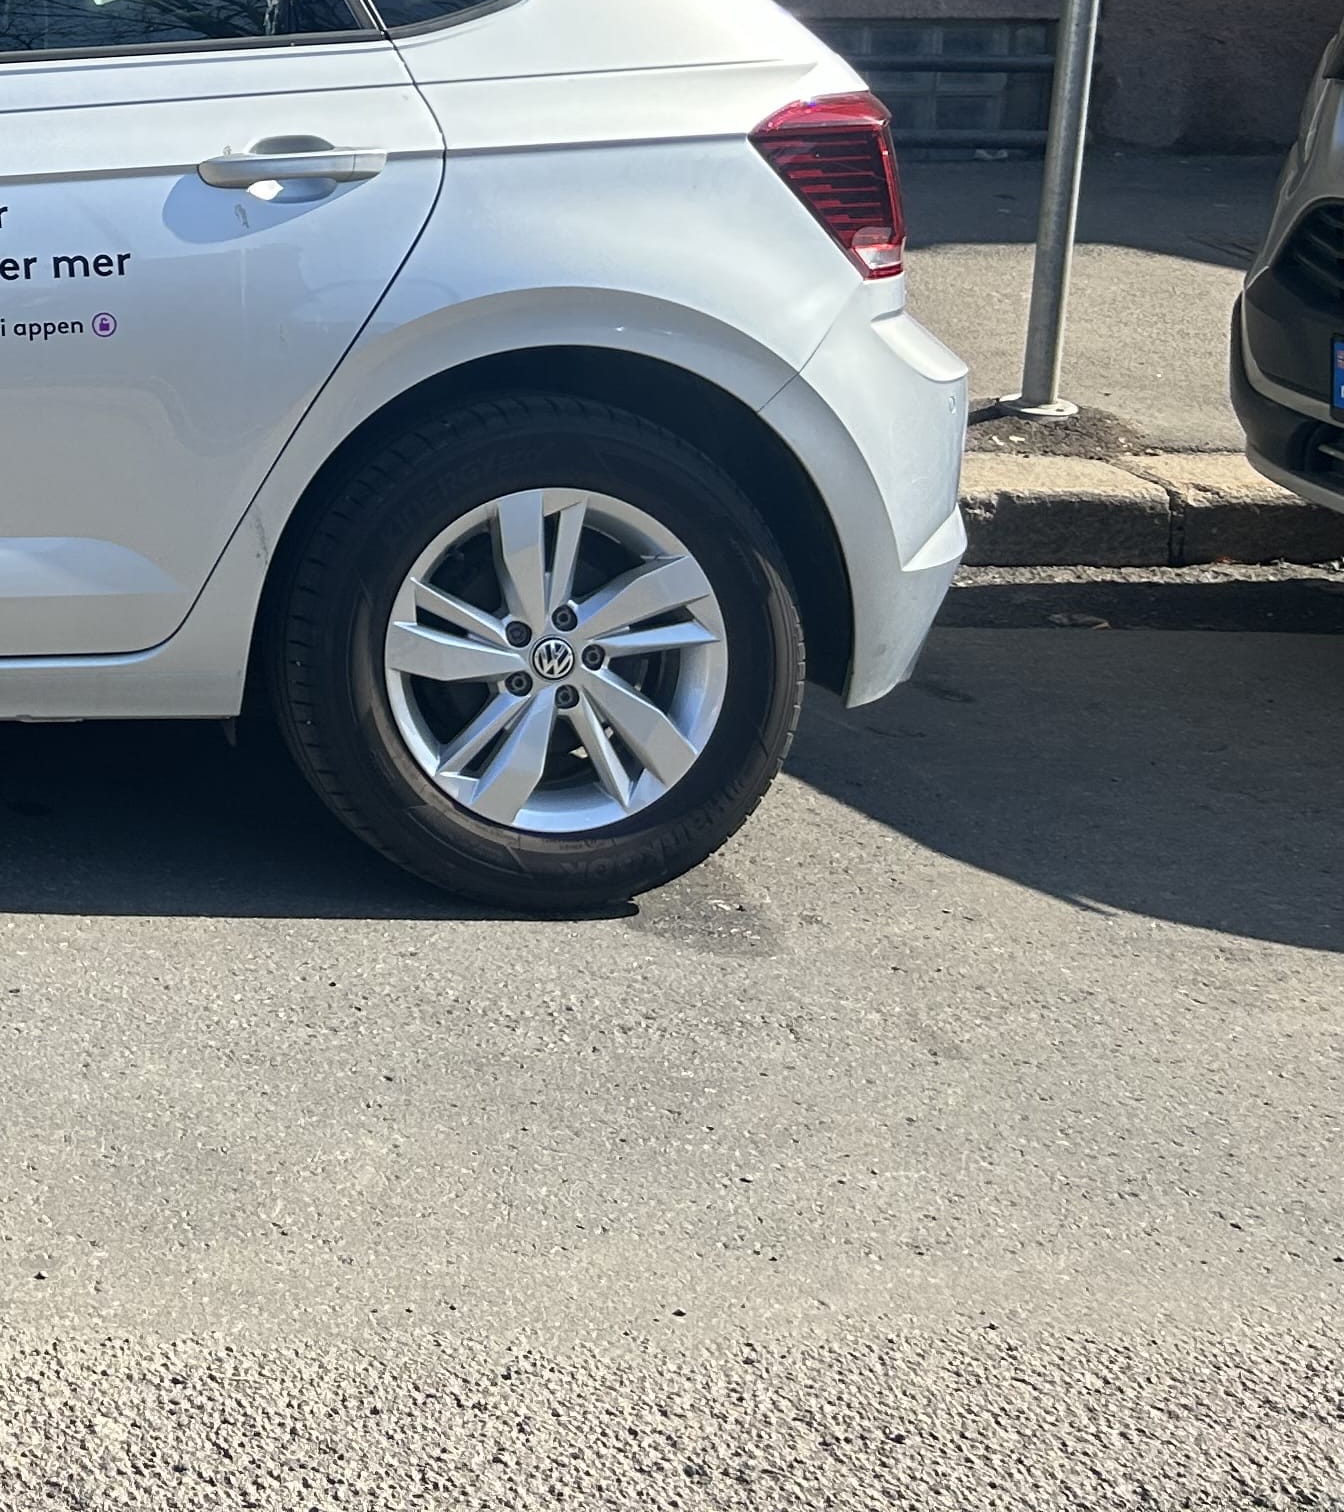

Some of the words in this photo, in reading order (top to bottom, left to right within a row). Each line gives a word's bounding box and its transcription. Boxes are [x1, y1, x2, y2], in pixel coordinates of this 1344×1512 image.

[52, 251, 132, 279] mer
[0, 318, 6, 337] i
[13, 319, 85, 342] appen
